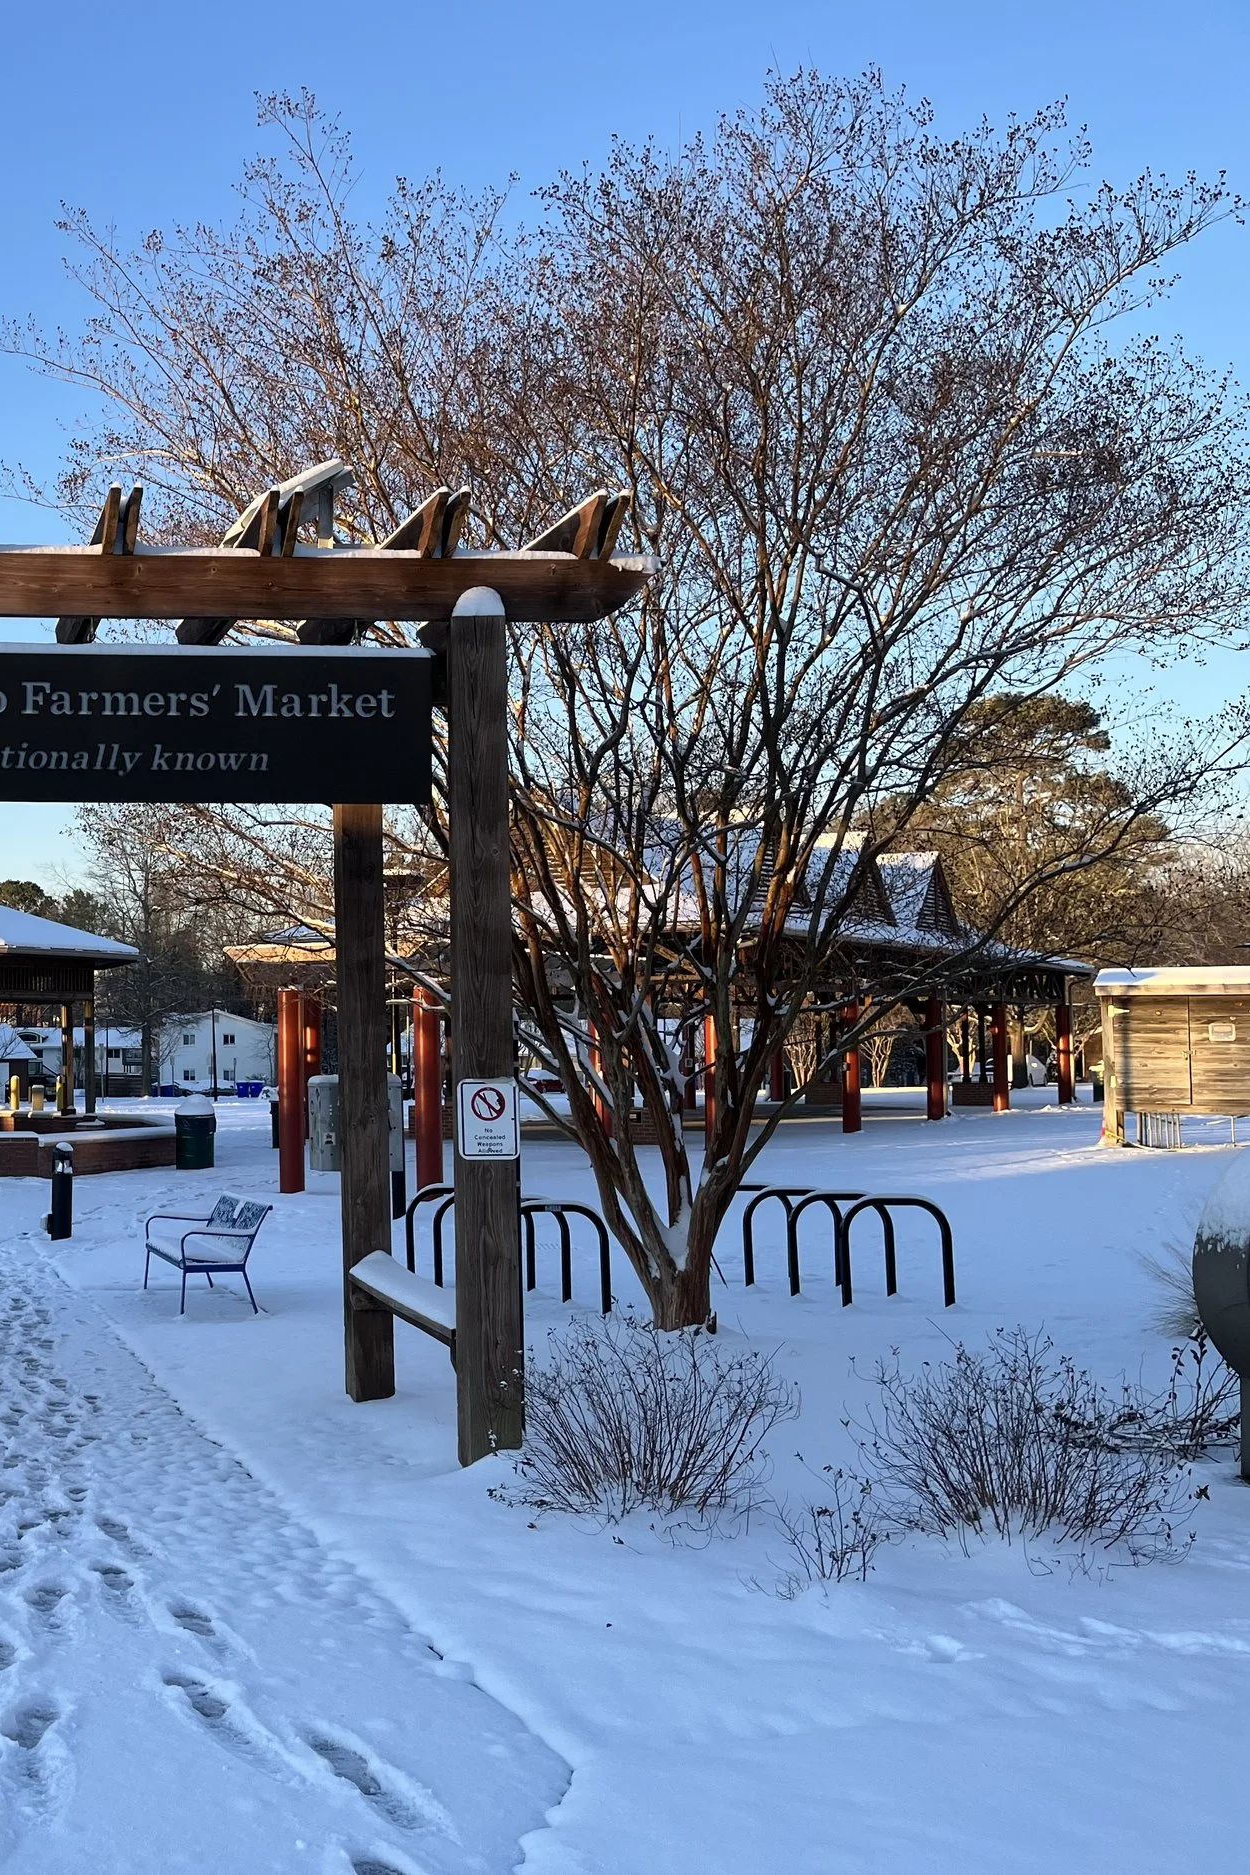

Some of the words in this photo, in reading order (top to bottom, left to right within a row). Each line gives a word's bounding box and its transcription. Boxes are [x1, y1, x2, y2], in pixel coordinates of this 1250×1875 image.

[21, 681, 221, 717] Farmers'
[234, 683, 396, 718] Market
[150, 744, 270, 771] known
